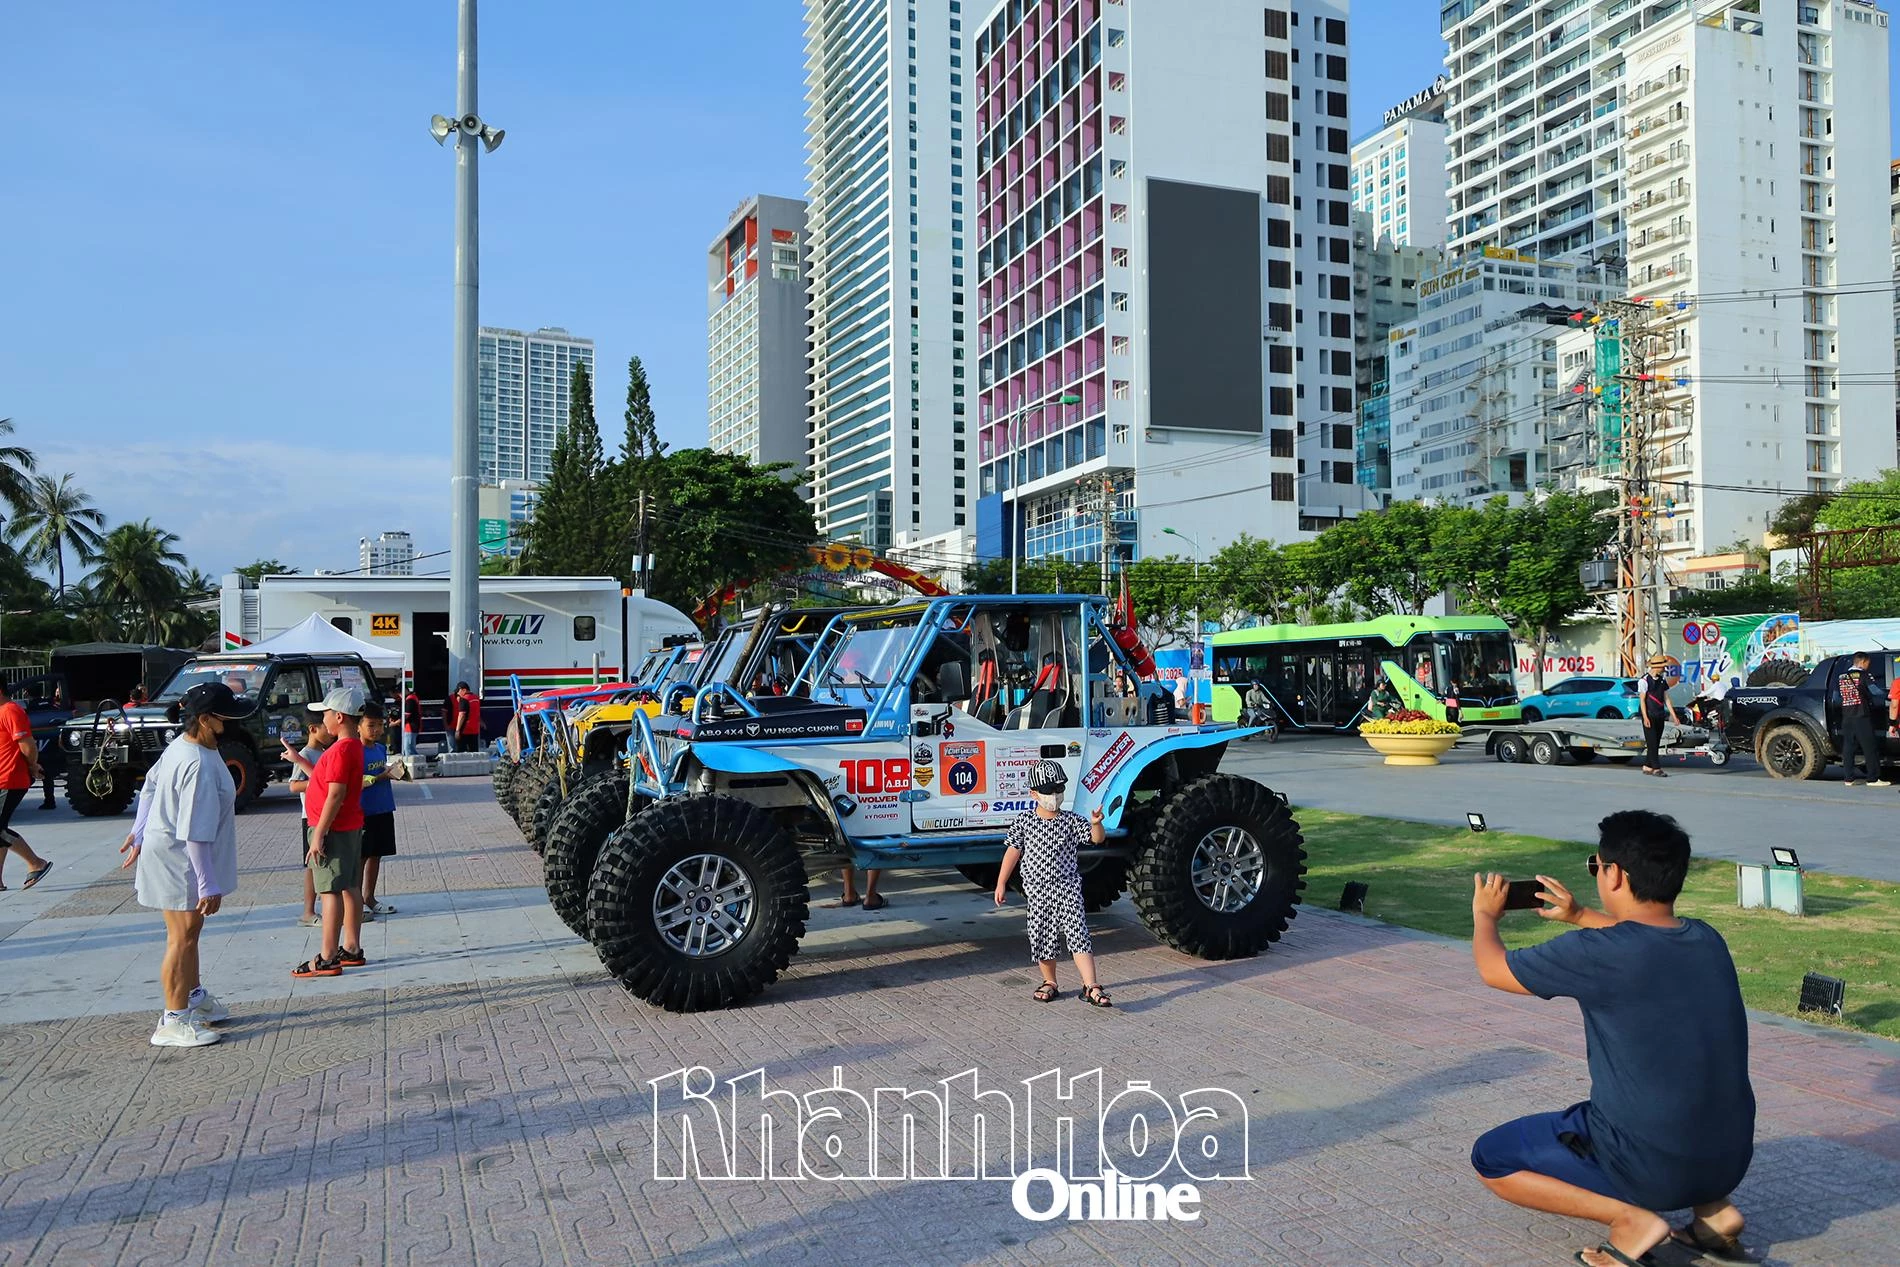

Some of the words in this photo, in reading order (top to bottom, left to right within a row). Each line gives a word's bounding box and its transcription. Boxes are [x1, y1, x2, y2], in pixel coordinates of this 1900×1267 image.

[1383, 87, 1432, 124] PANAMA
[1420, 277, 1440, 298] SUN
[1440, 267, 1464, 290] CITY
[373, 616, 398, 630] 4K
[484, 614, 545, 635] KTV
[484, 637, 543, 646] ww.ktv.org.vn
[1558, 656, 1595, 673] 2025
[778, 726, 805, 734] NGOC
[1094, 735, 1132, 773] WOLVER
[839, 758, 911, 794] 108
[955, 772, 973, 785] 104
[857, 795, 898, 804] WOLVER
[992, 801, 1038, 812] SAILU
